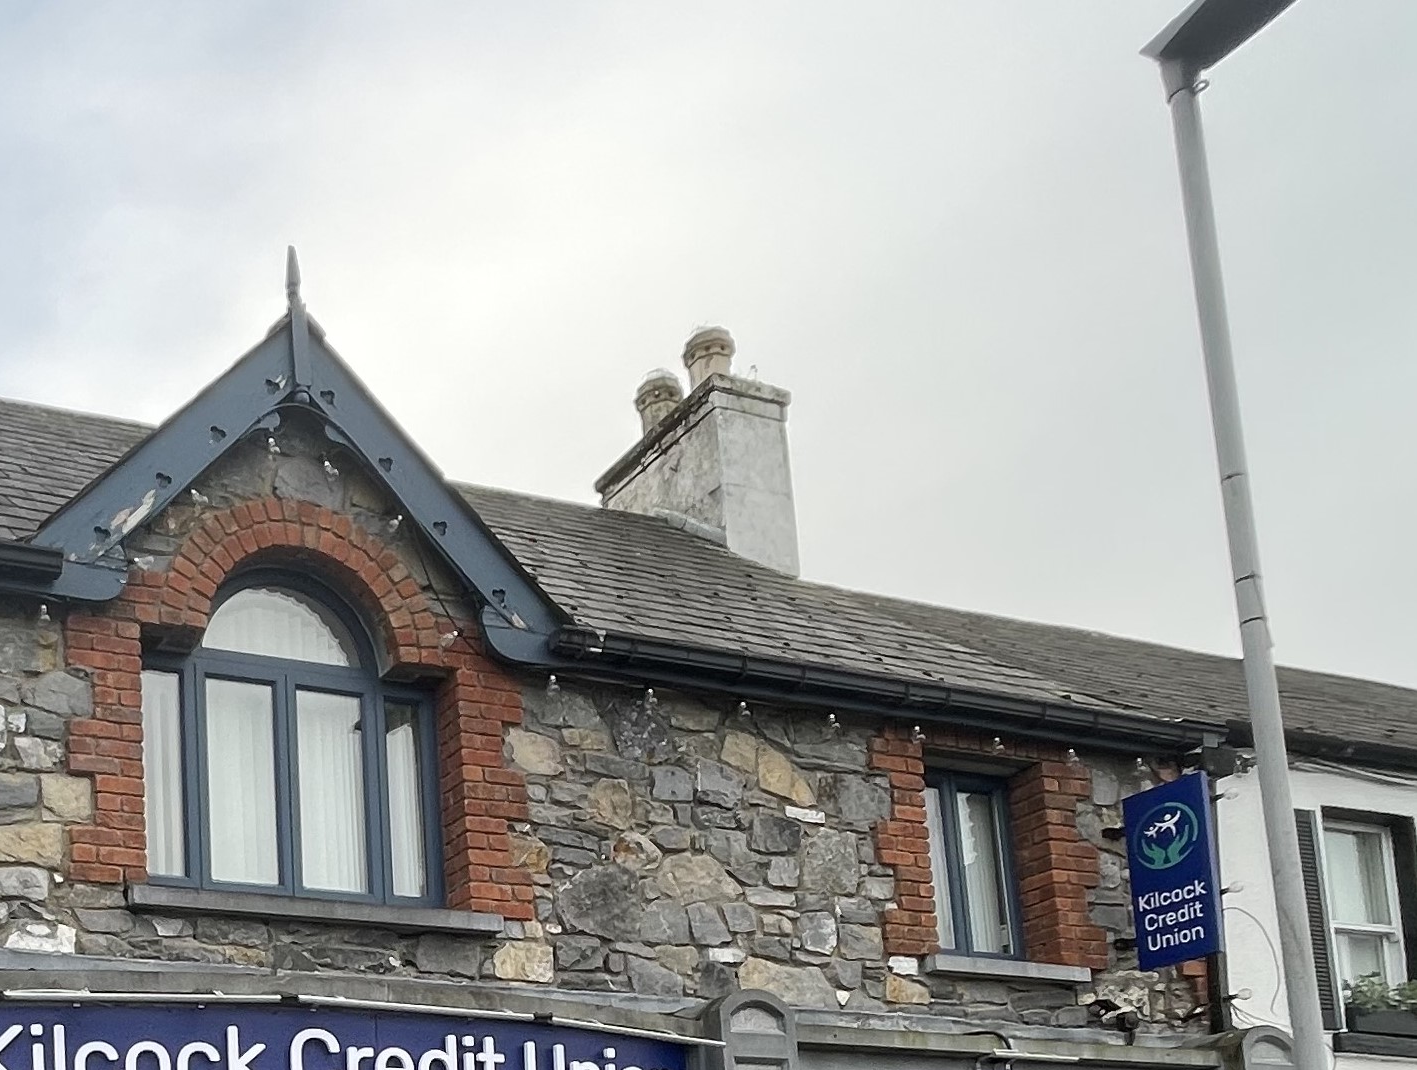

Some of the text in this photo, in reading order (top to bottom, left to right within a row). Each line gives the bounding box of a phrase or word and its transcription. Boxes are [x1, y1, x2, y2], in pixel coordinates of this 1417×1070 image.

[1138, 880, 1207, 912] Kilcock
[1144, 901, 1204, 931] Credit
[1147, 925, 1205, 951] Union
